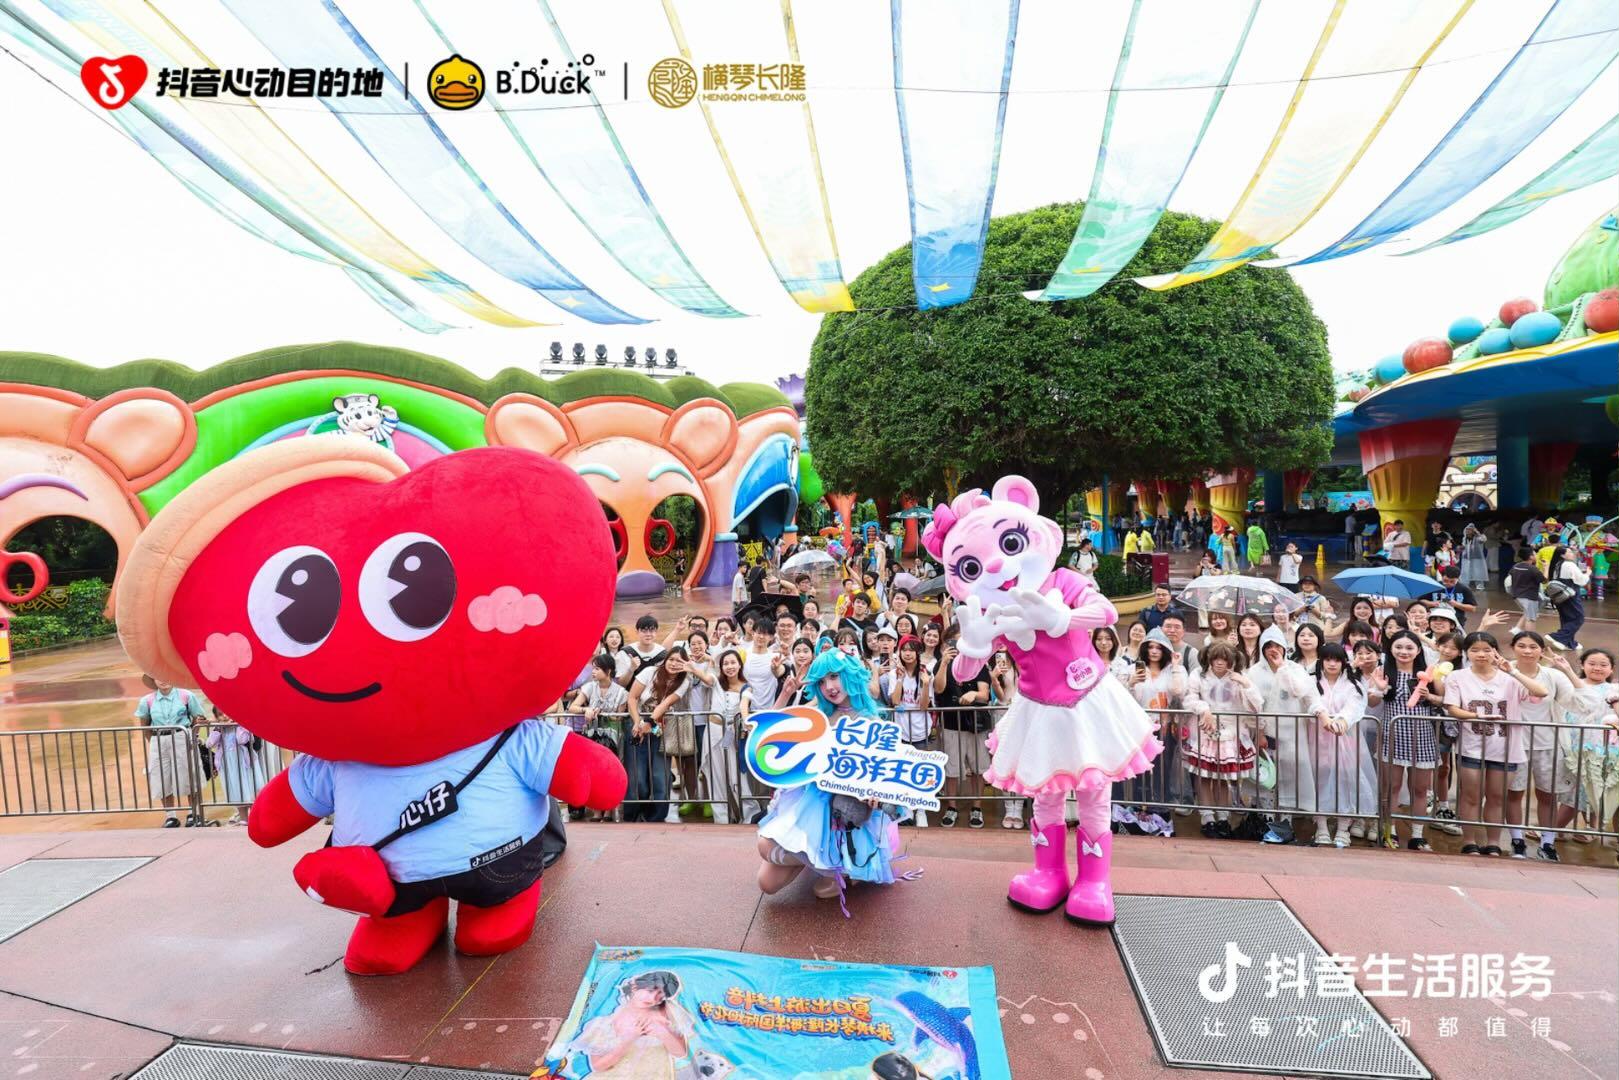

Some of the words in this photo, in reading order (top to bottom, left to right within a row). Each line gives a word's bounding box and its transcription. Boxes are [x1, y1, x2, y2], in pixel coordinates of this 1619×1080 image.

[834, 717, 900, 752] 长隆
[823, 747, 943, 793] 海洋王国
[904, 748, 947, 762] HengQin
[401, 782, 450, 829] 心仔
[819, 779, 866, 797] Chimelong
[866, 788, 895, 801] Ocean
[895, 792, 938, 809] Kingdom
